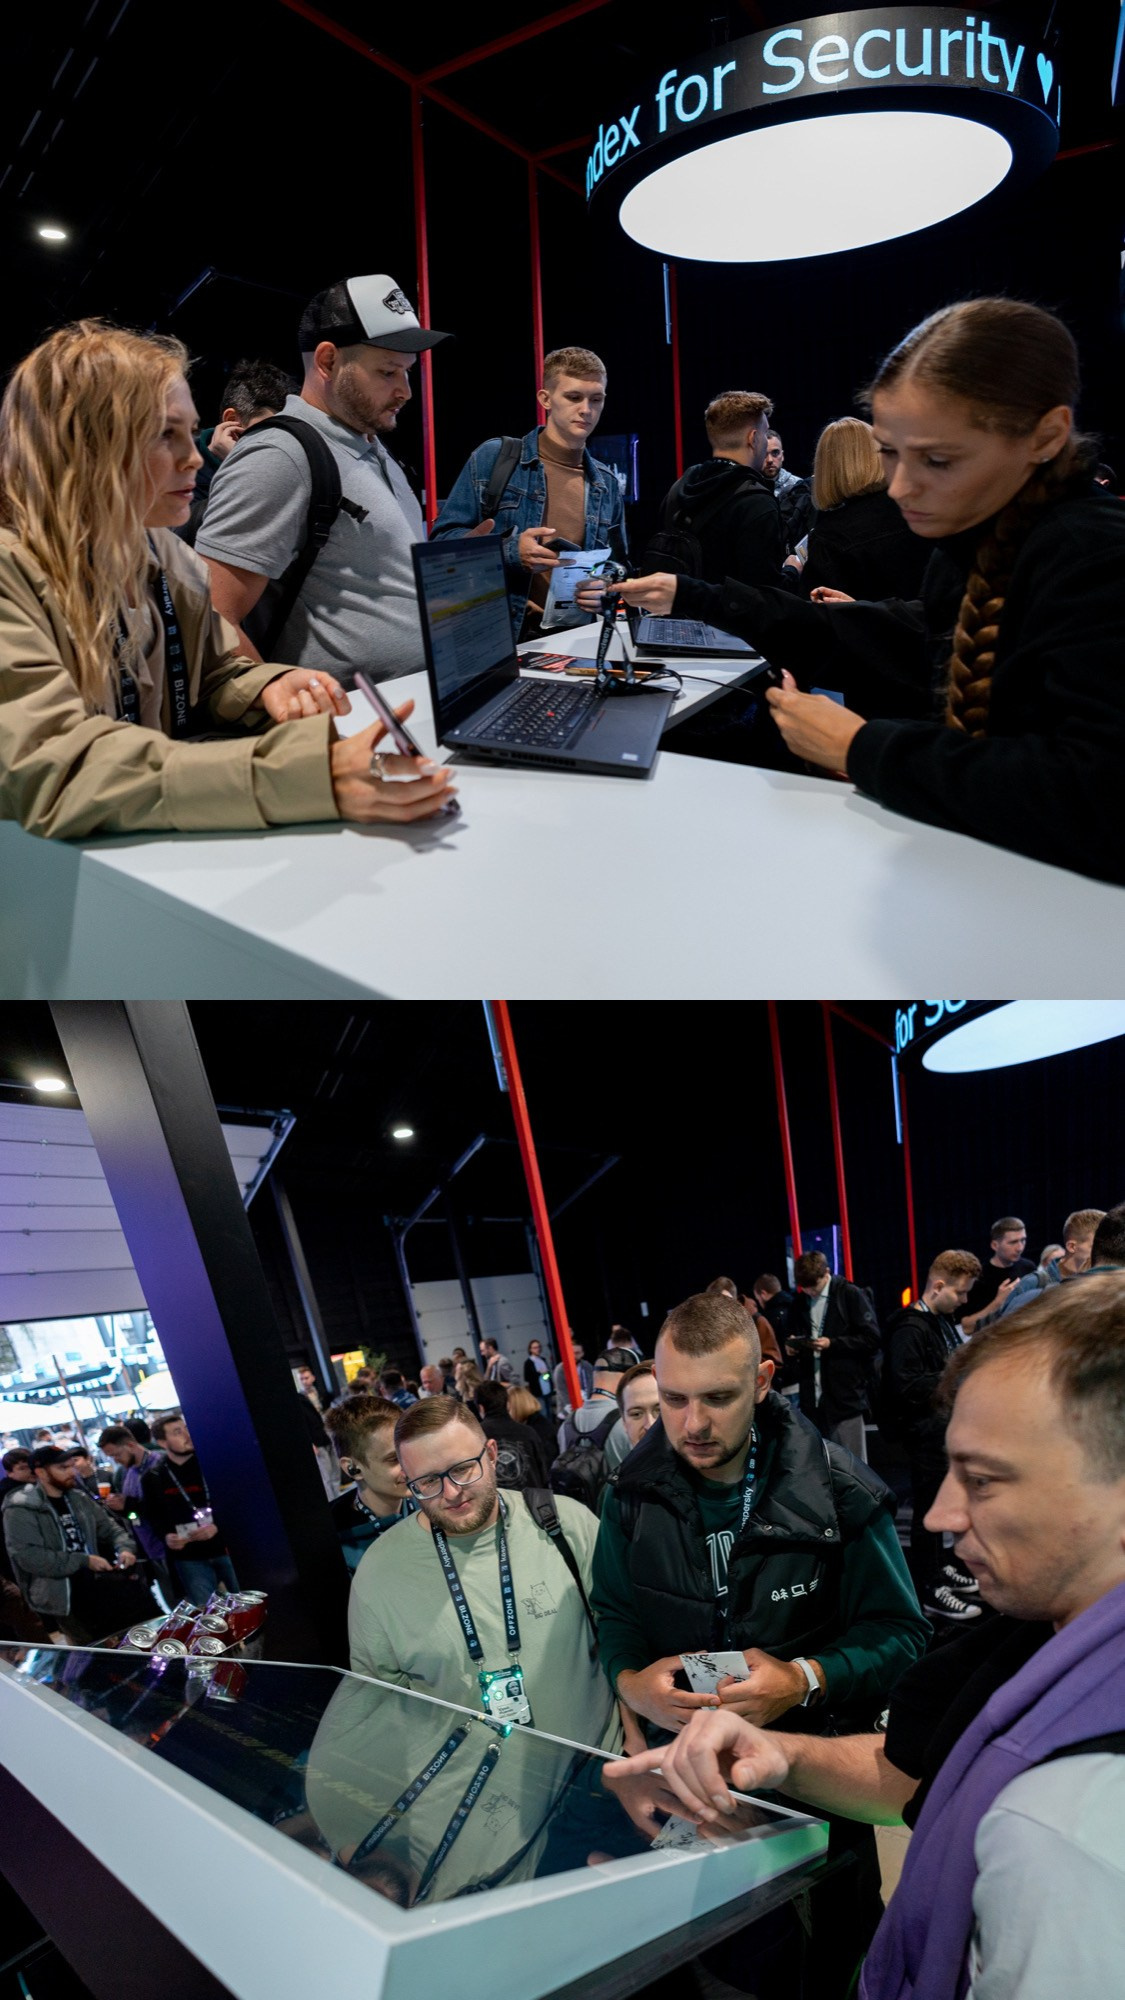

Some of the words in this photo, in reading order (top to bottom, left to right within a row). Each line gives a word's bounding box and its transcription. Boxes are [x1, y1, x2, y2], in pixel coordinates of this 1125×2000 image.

[655, 60, 737, 133] for
[762, 16, 1025, 95] Security
[174, 678, 186, 726] BI.ZONE
[895, 1003, 917, 1054] for
[435, 1531, 452, 1568] kaspersky
[458, 1604, 475, 1636] BI.ZONE
[505, 1598, 517, 1636] OFFZONE
